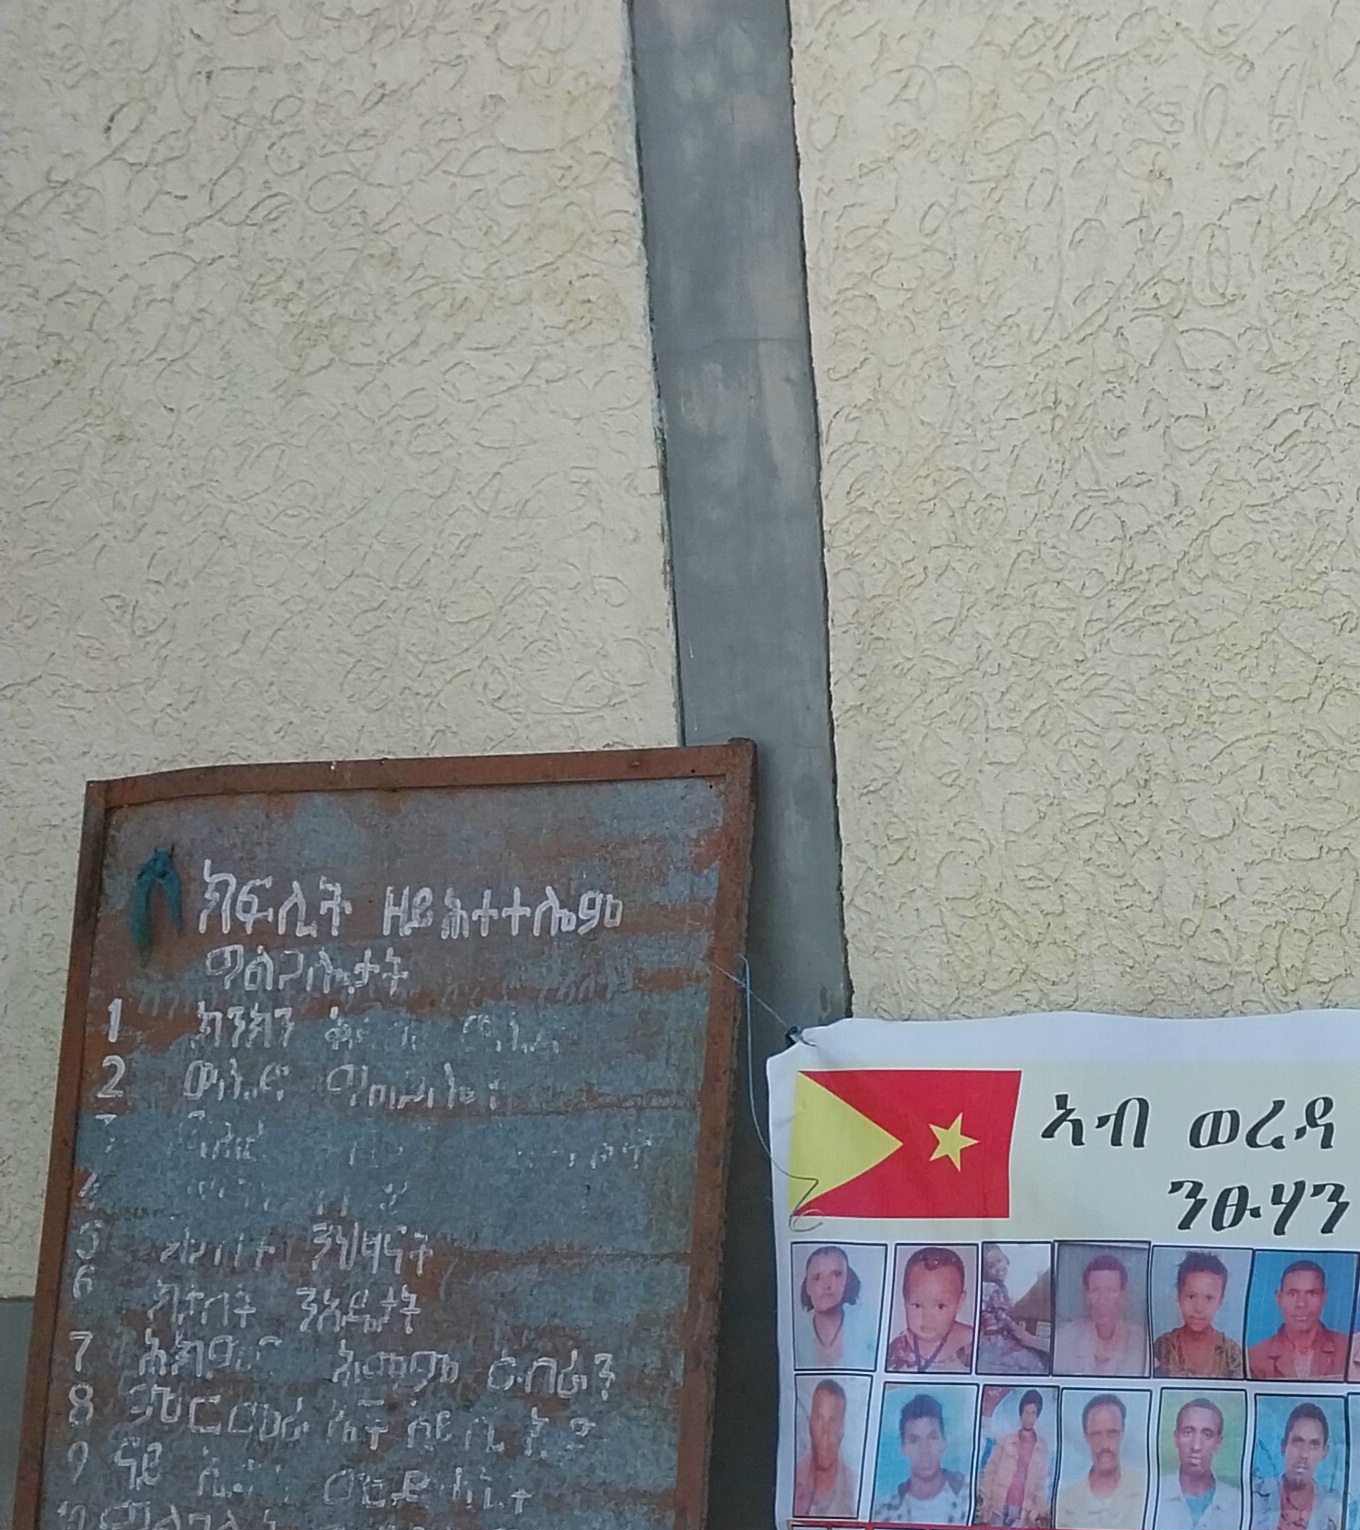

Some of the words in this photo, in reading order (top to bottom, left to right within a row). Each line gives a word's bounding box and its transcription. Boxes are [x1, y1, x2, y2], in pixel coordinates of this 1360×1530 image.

[107, 998, 123, 1043] 1
[96, 1055, 126, 1099] 2
[1041, 1093, 1150, 1148] ኣብ
[1189, 1096, 1334, 1150] ወረዳ
[1168, 1180, 1350, 1236] ንፁሃን
[73, 1264, 96, 1298] 6
[68, 1330, 93, 1372] 7
[69, 1382, 94, 1427] 8
[67, 1440, 89, 1485] 9
